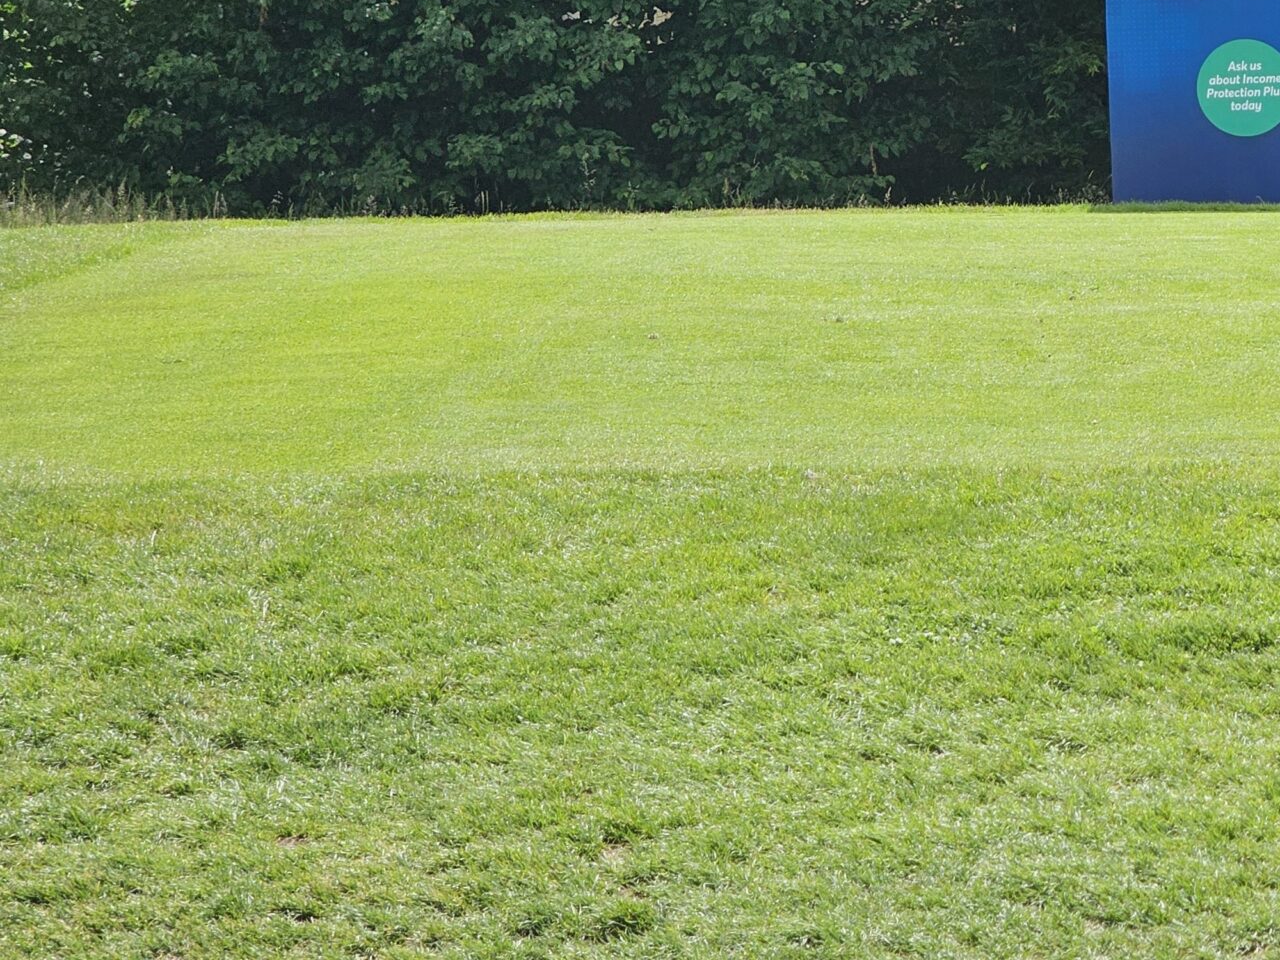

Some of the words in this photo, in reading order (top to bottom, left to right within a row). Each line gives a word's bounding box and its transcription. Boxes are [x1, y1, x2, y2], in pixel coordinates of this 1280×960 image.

[1228, 61, 1247, 71] Ask
[1249, 62, 1262, 71] us
[1209, 75, 1240, 85] about
[1206, 87, 1261, 99] Protection
[1231, 100, 1262, 112] today
